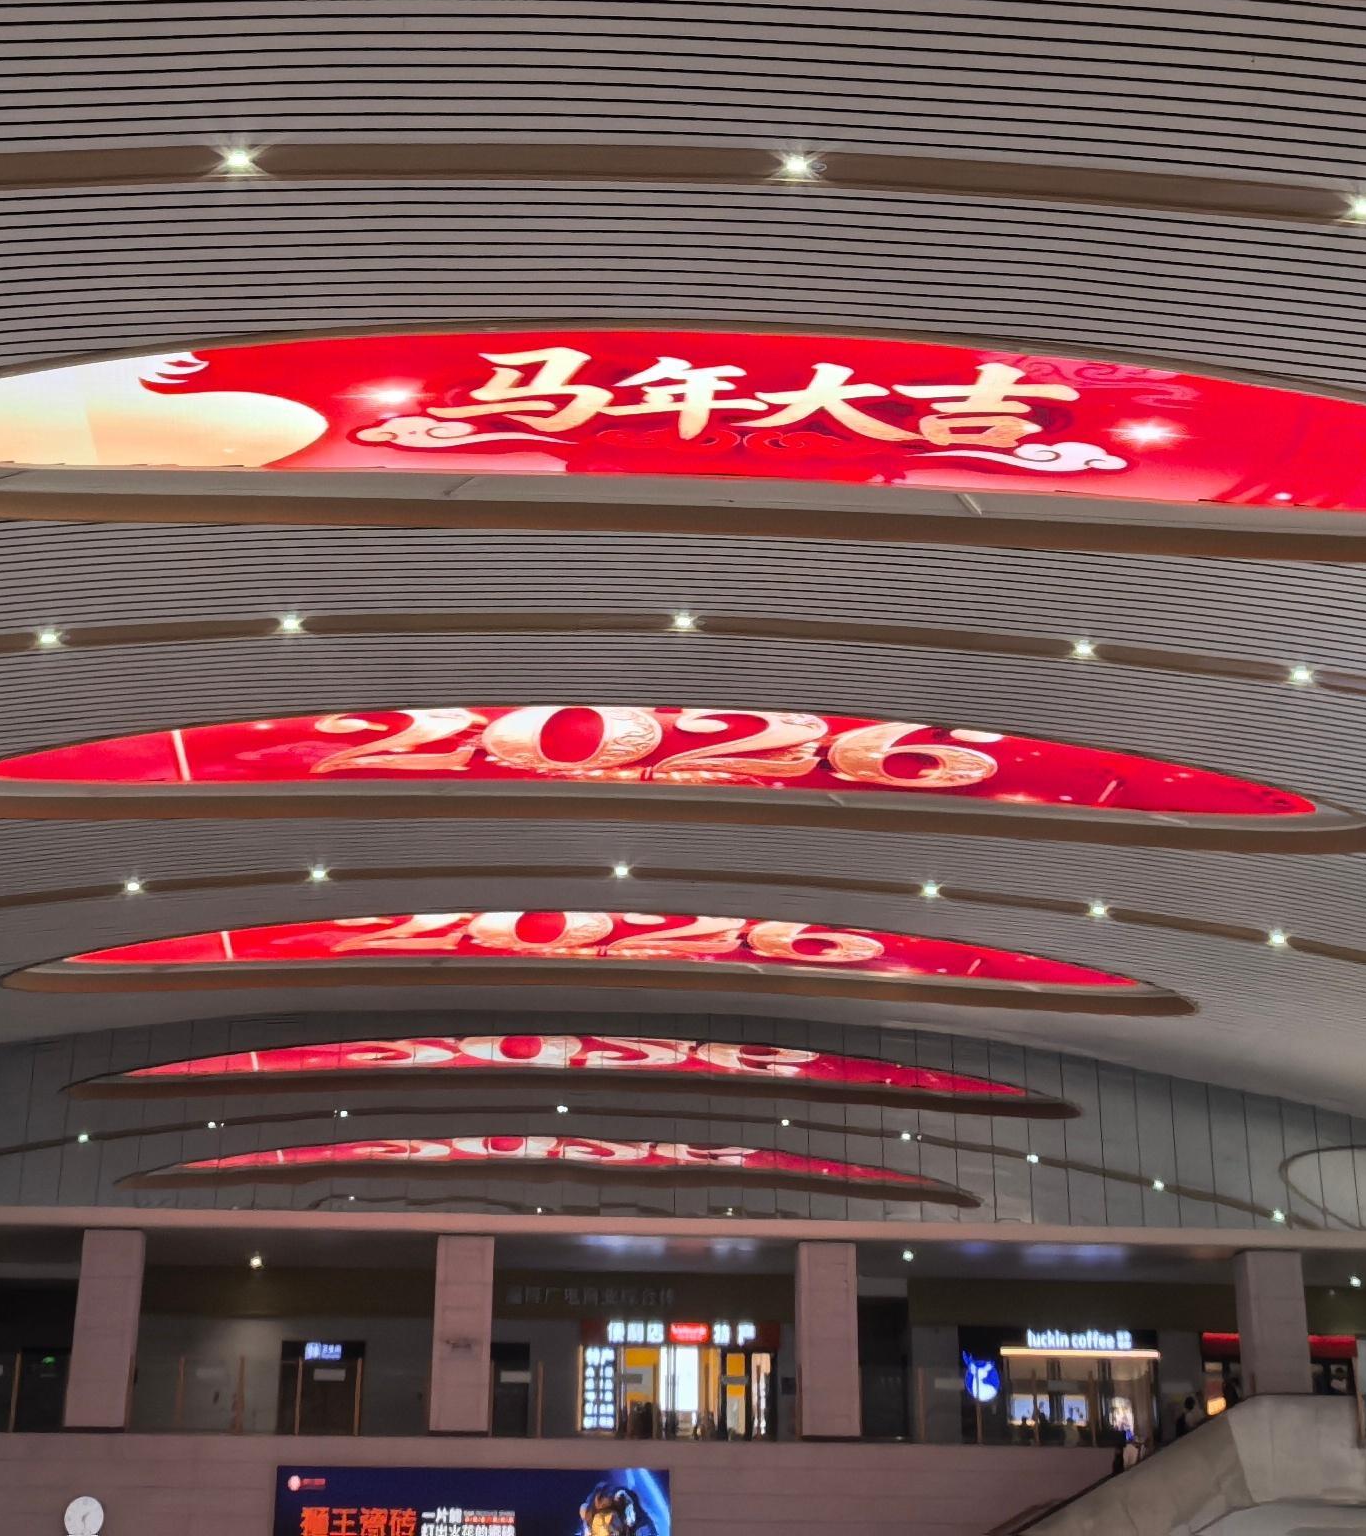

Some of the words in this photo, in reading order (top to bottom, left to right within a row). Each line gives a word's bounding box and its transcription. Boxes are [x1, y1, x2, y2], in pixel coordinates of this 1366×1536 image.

[428, 347, 1078, 447] 马年大吉
[309, 705, 1001, 788] 2026
[1026, 1329, 1069, 1348] luckin
[1071, 1330, 1115, 1350] coffee
